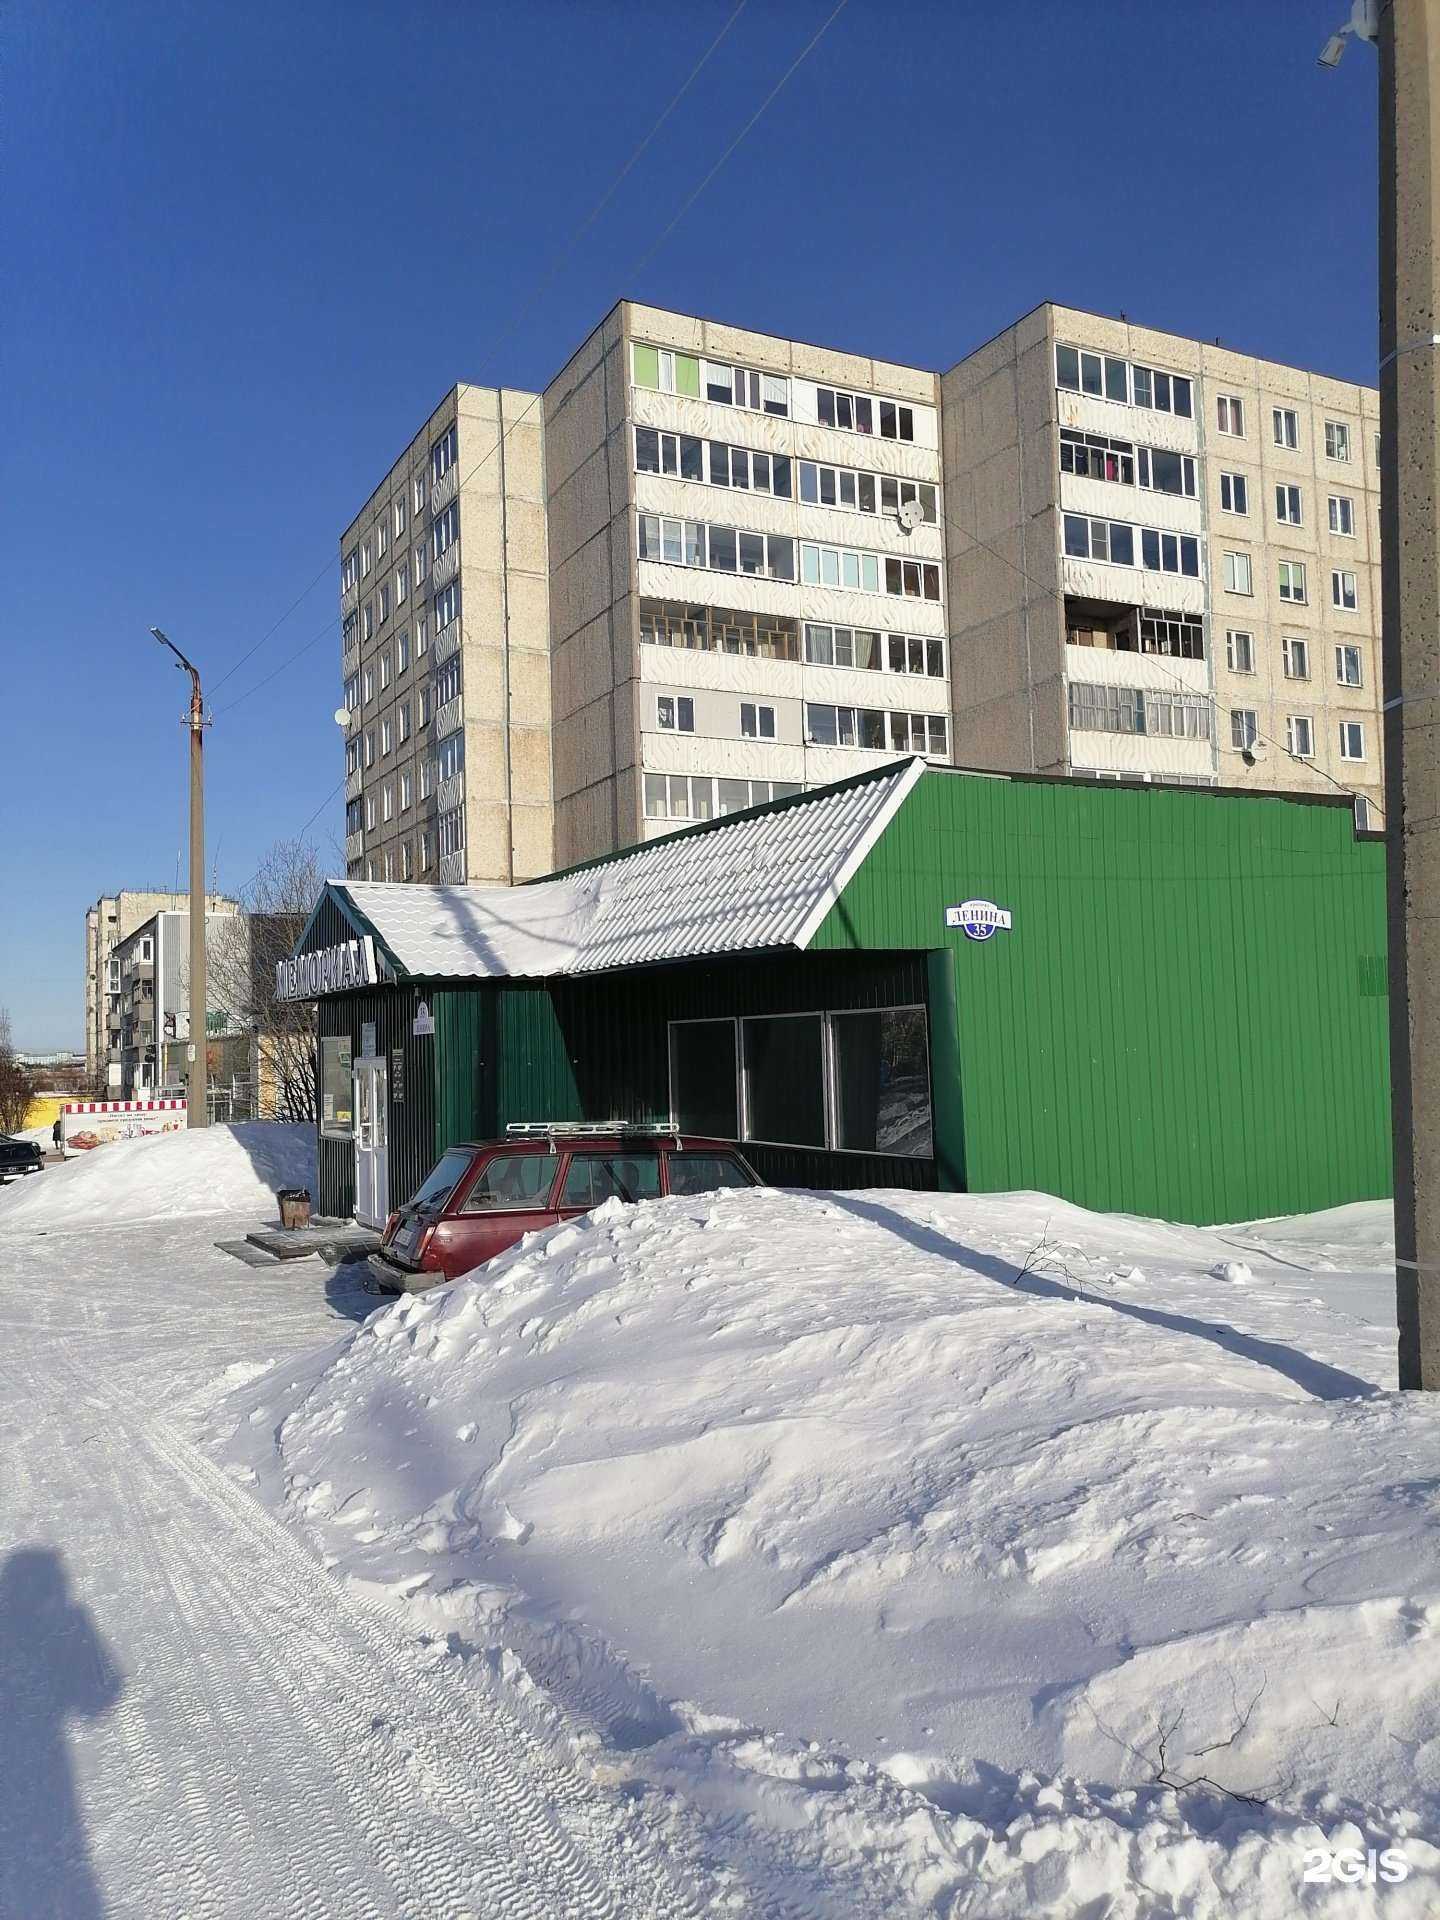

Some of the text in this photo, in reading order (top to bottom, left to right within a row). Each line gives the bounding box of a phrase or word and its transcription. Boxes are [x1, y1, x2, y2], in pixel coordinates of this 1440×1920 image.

[952, 910, 1007, 925] ЛЕНИНА
[974, 923, 987, 936] 35
[274, 934, 378, 1002] МЕМОРИАЛ
